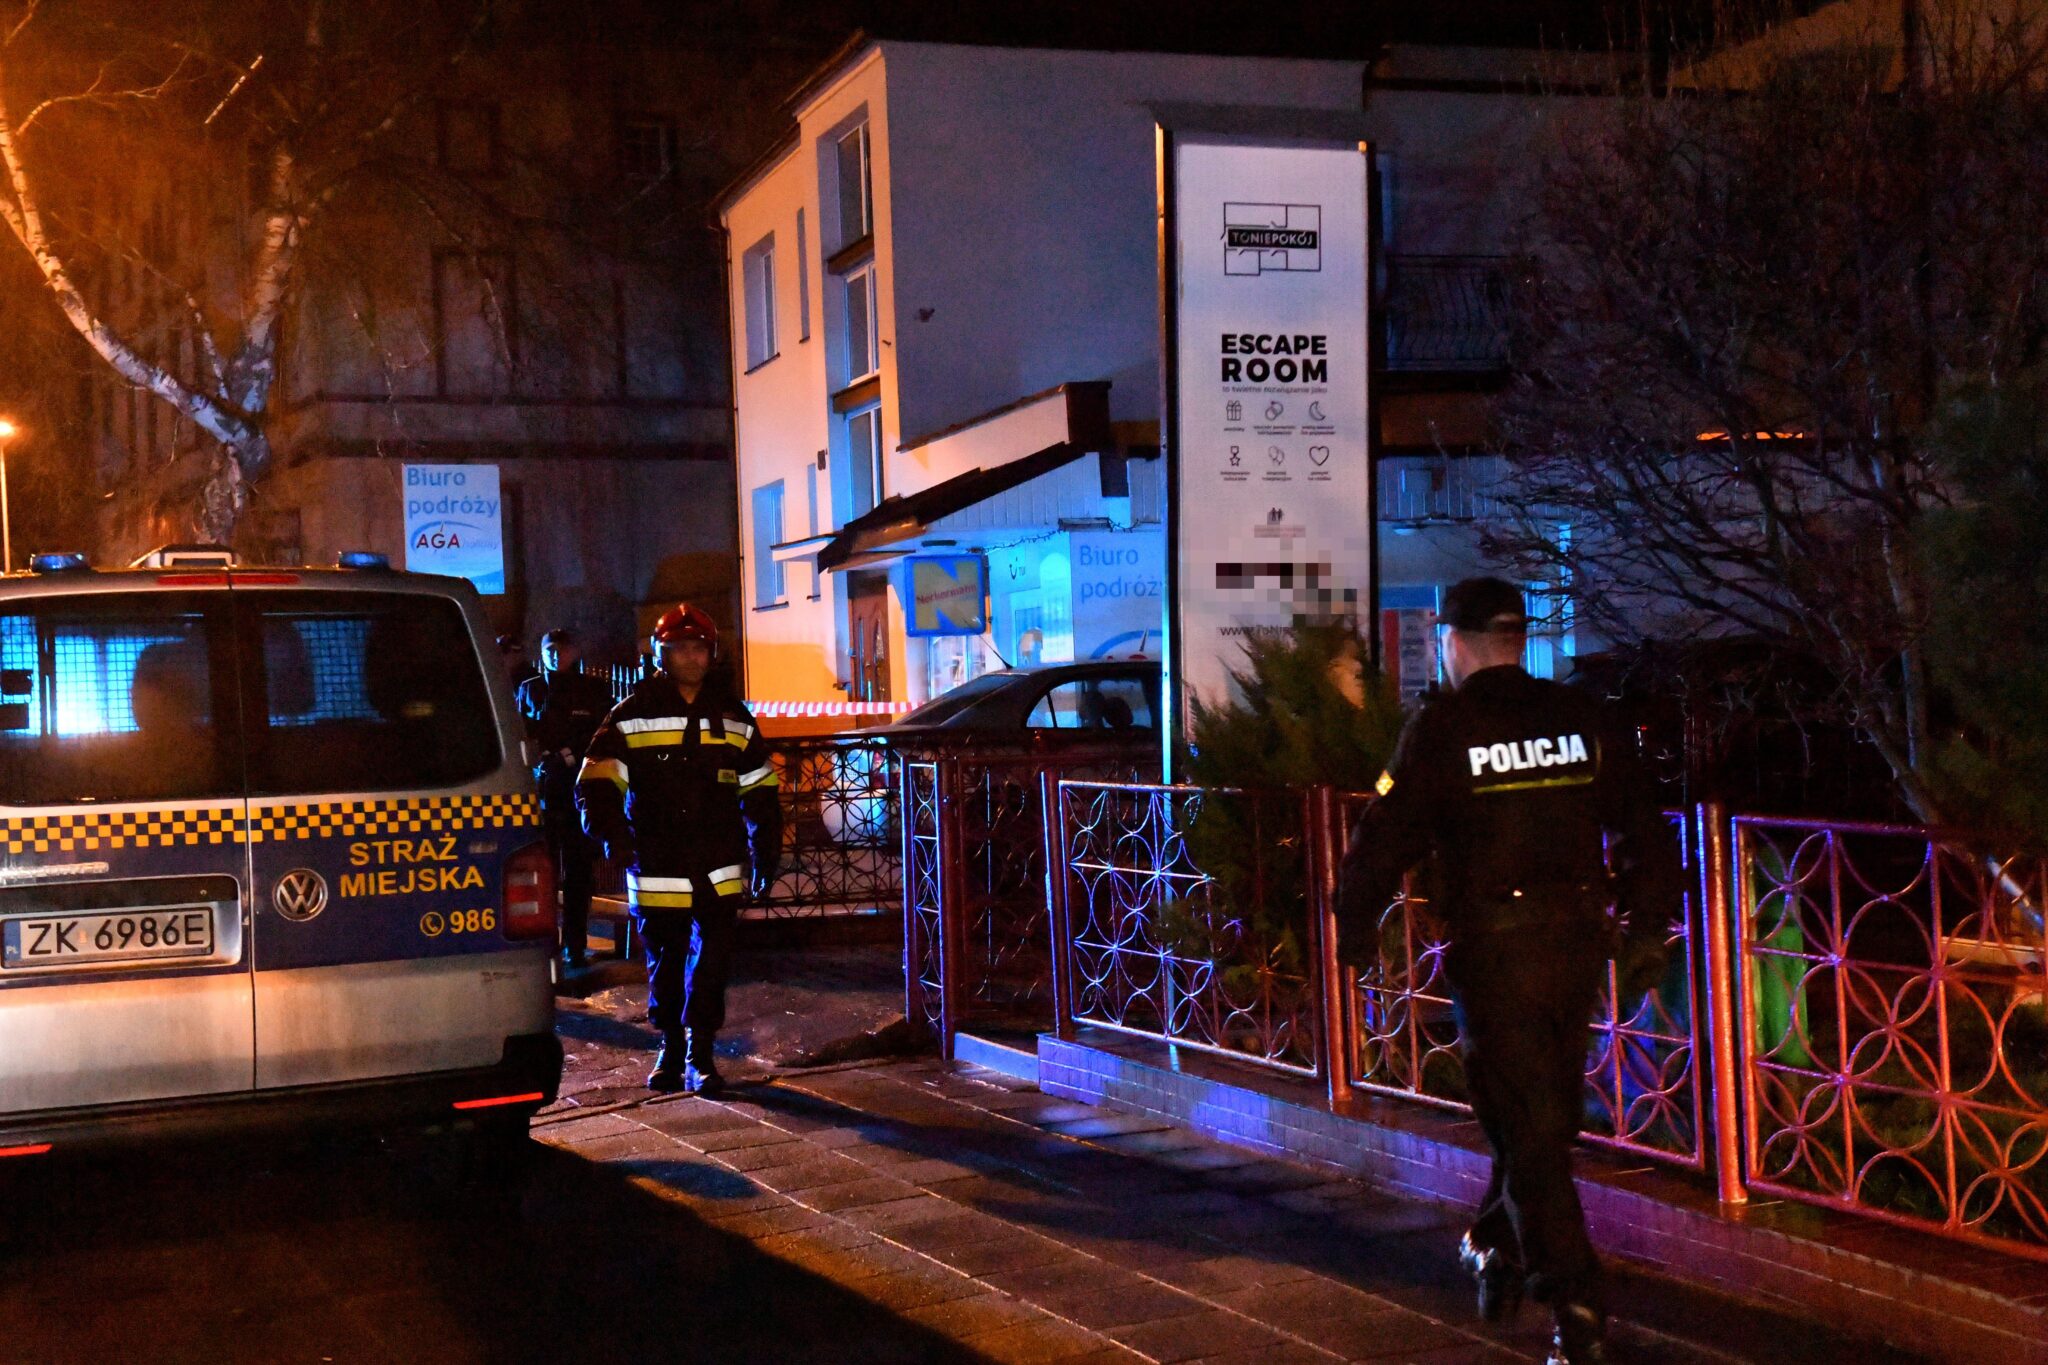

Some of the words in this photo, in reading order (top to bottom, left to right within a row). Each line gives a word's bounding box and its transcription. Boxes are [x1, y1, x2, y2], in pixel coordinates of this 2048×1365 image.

[1232, 231, 1314, 246] TONIEPOKÓJ
[1221, 334, 1328, 355] ESCAPE
[1221, 358, 1328, 383] ROOM
[407, 467, 466, 487] Biuro
[408, 496, 499, 519] podróży
[416, 532, 461, 549] AGA
[1080, 545, 1139, 566] Biuro
[1081, 574, 1163, 604] podróż
[1468, 734, 1588, 777] POLICJA
[350, 832, 458, 866] STRAŻ
[340, 865, 485, 898] MIEJSKA
[450, 908, 496, 934] 986
[28, 921, 79, 955] ZK
[94, 914, 204, 950] 6986E
